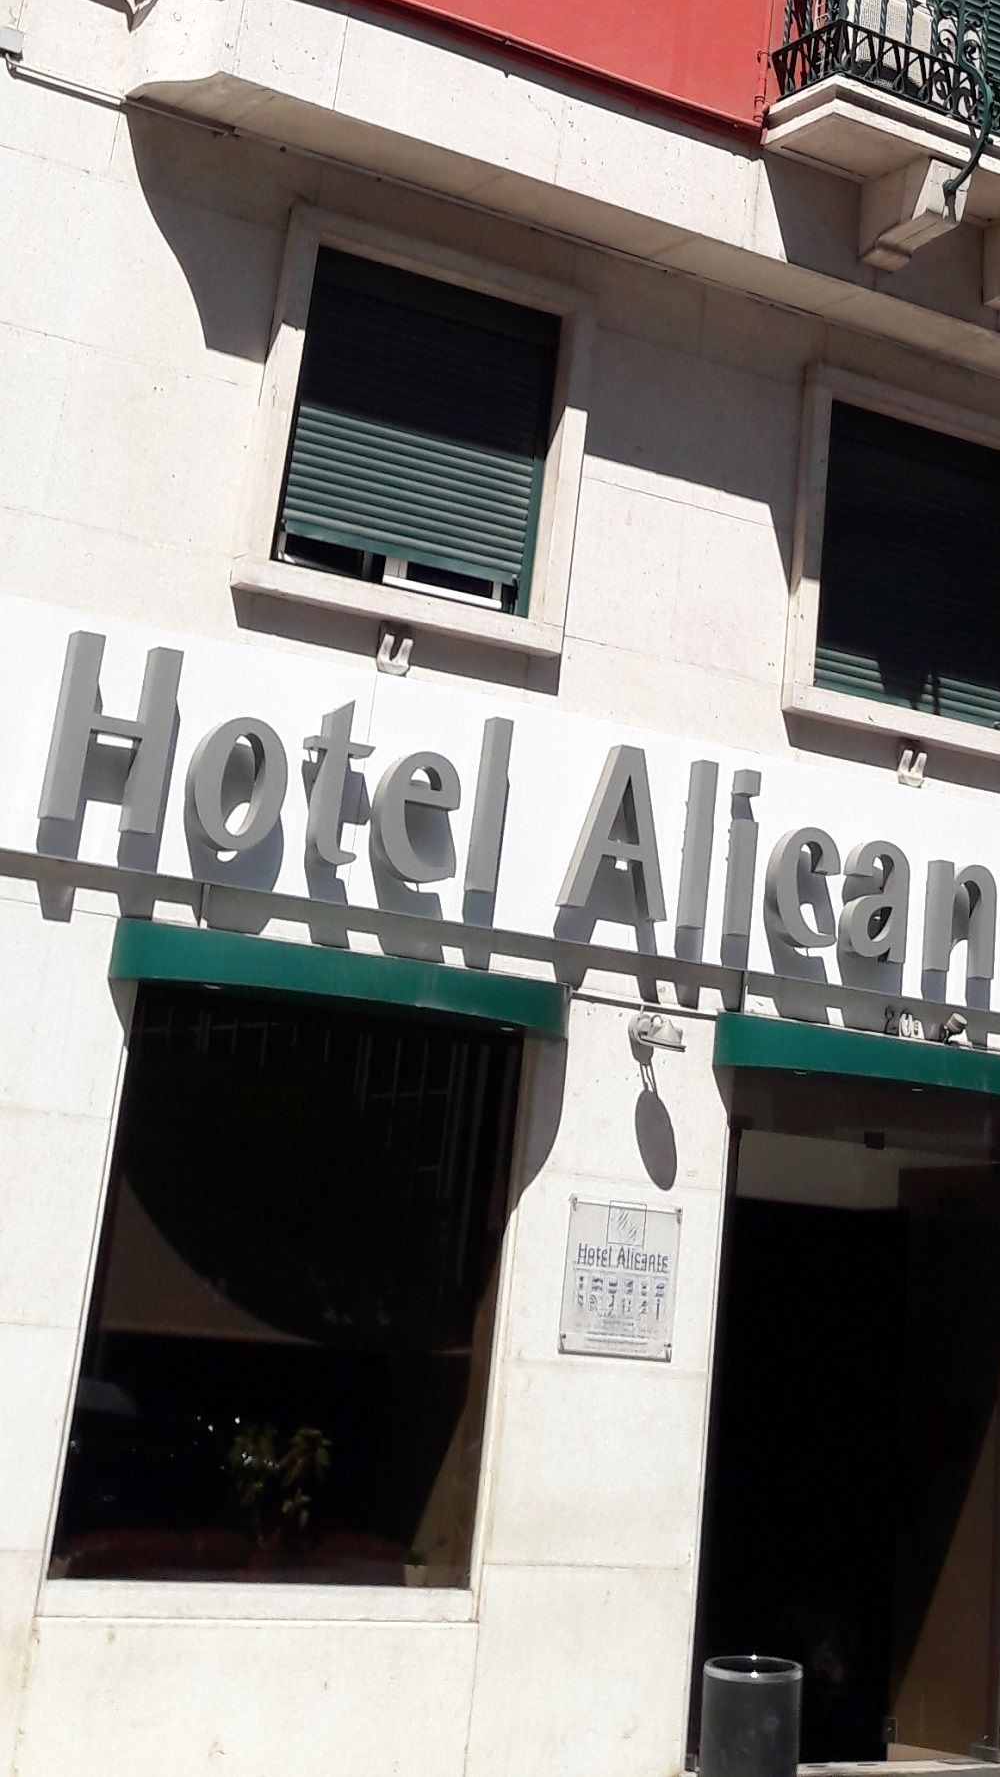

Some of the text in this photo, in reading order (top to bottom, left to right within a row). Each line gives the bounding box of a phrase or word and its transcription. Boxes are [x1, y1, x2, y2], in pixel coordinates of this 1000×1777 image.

[37, 630, 515, 896] Hotel
[577, 1242, 670, 1273] Hotel Alicante
